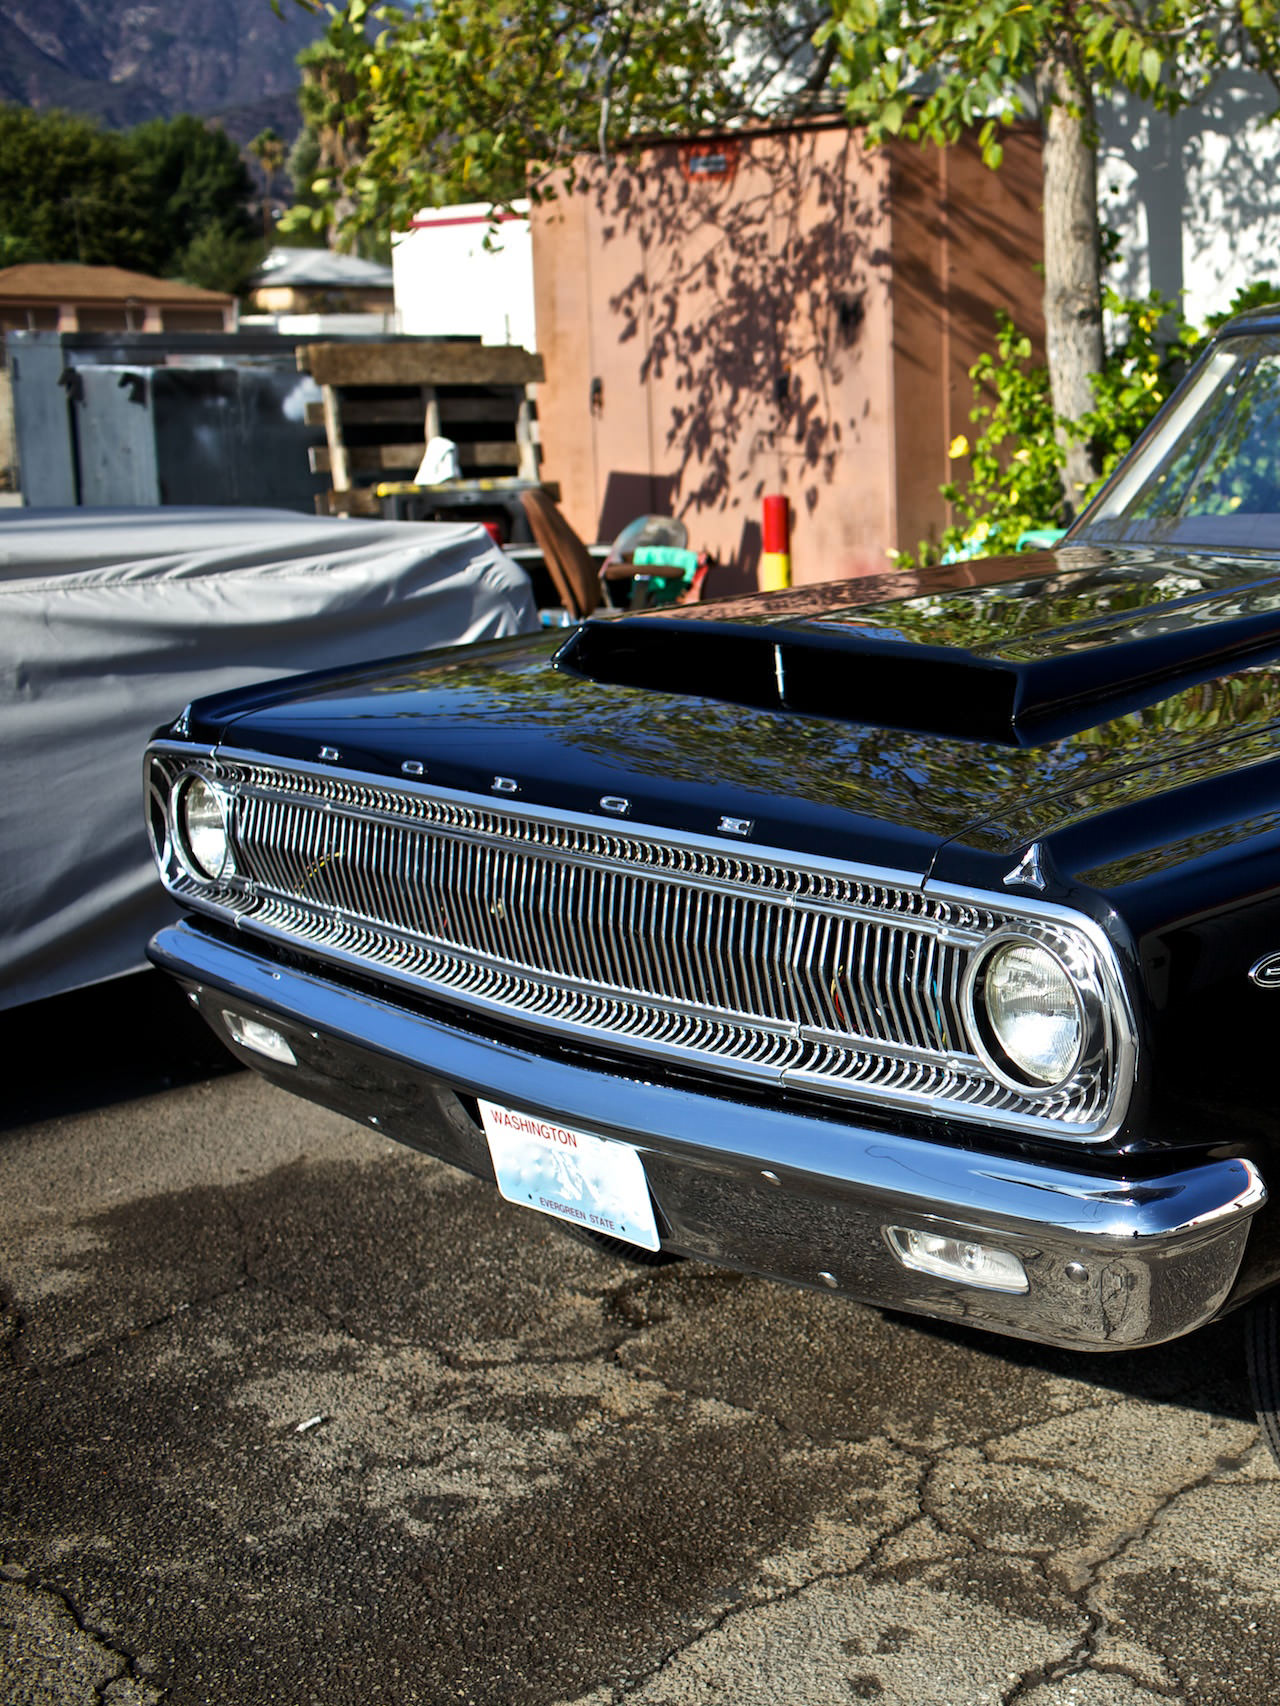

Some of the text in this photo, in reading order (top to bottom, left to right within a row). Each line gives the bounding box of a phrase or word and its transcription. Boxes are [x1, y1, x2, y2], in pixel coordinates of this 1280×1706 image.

[319, 744, 755, 836] DODGE
[491, 1109, 578, 1148] WASHINGTON
[540, 1197, 616, 1230] EVERGREEN STATE
